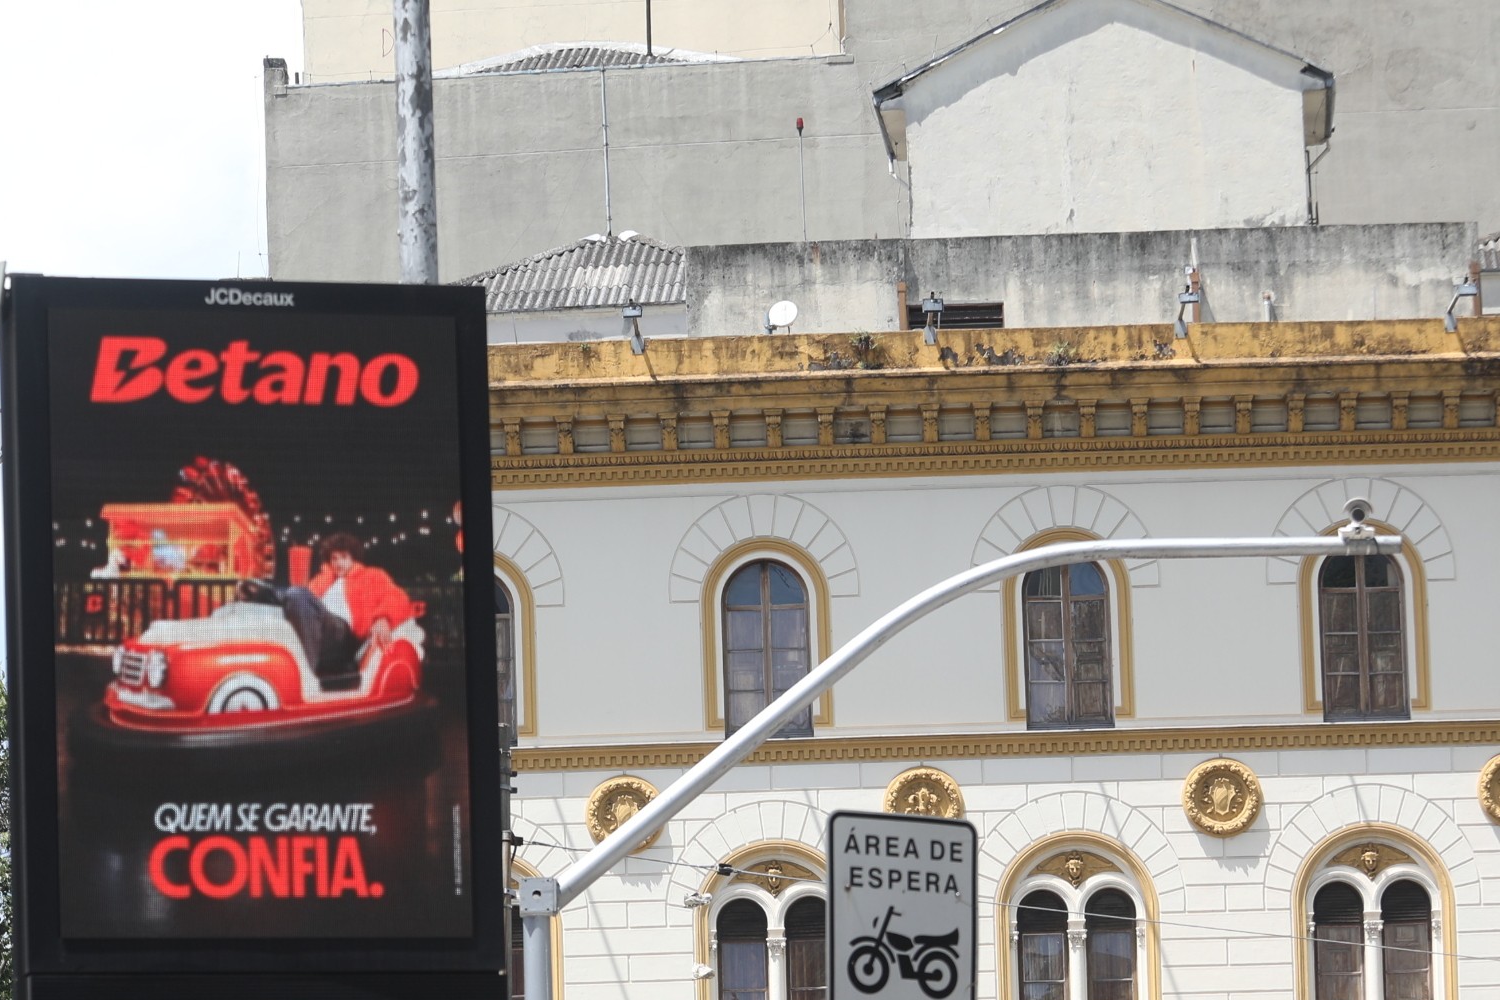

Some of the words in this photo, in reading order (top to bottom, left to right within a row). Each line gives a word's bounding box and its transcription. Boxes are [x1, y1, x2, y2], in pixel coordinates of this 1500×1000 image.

[204, 287, 295, 307] JCDecaux
[89, 335, 420, 408] Betano
[154, 803, 233, 832] QUEM
[235, 803, 260, 831] SE
[264, 802, 377, 834] GARANTE,
[844, 827, 920, 860] ÁREA
[930, 840, 963, 863] DE
[148, 836, 385, 898] CONFIA.
[850, 866, 960, 895] ESPERA
